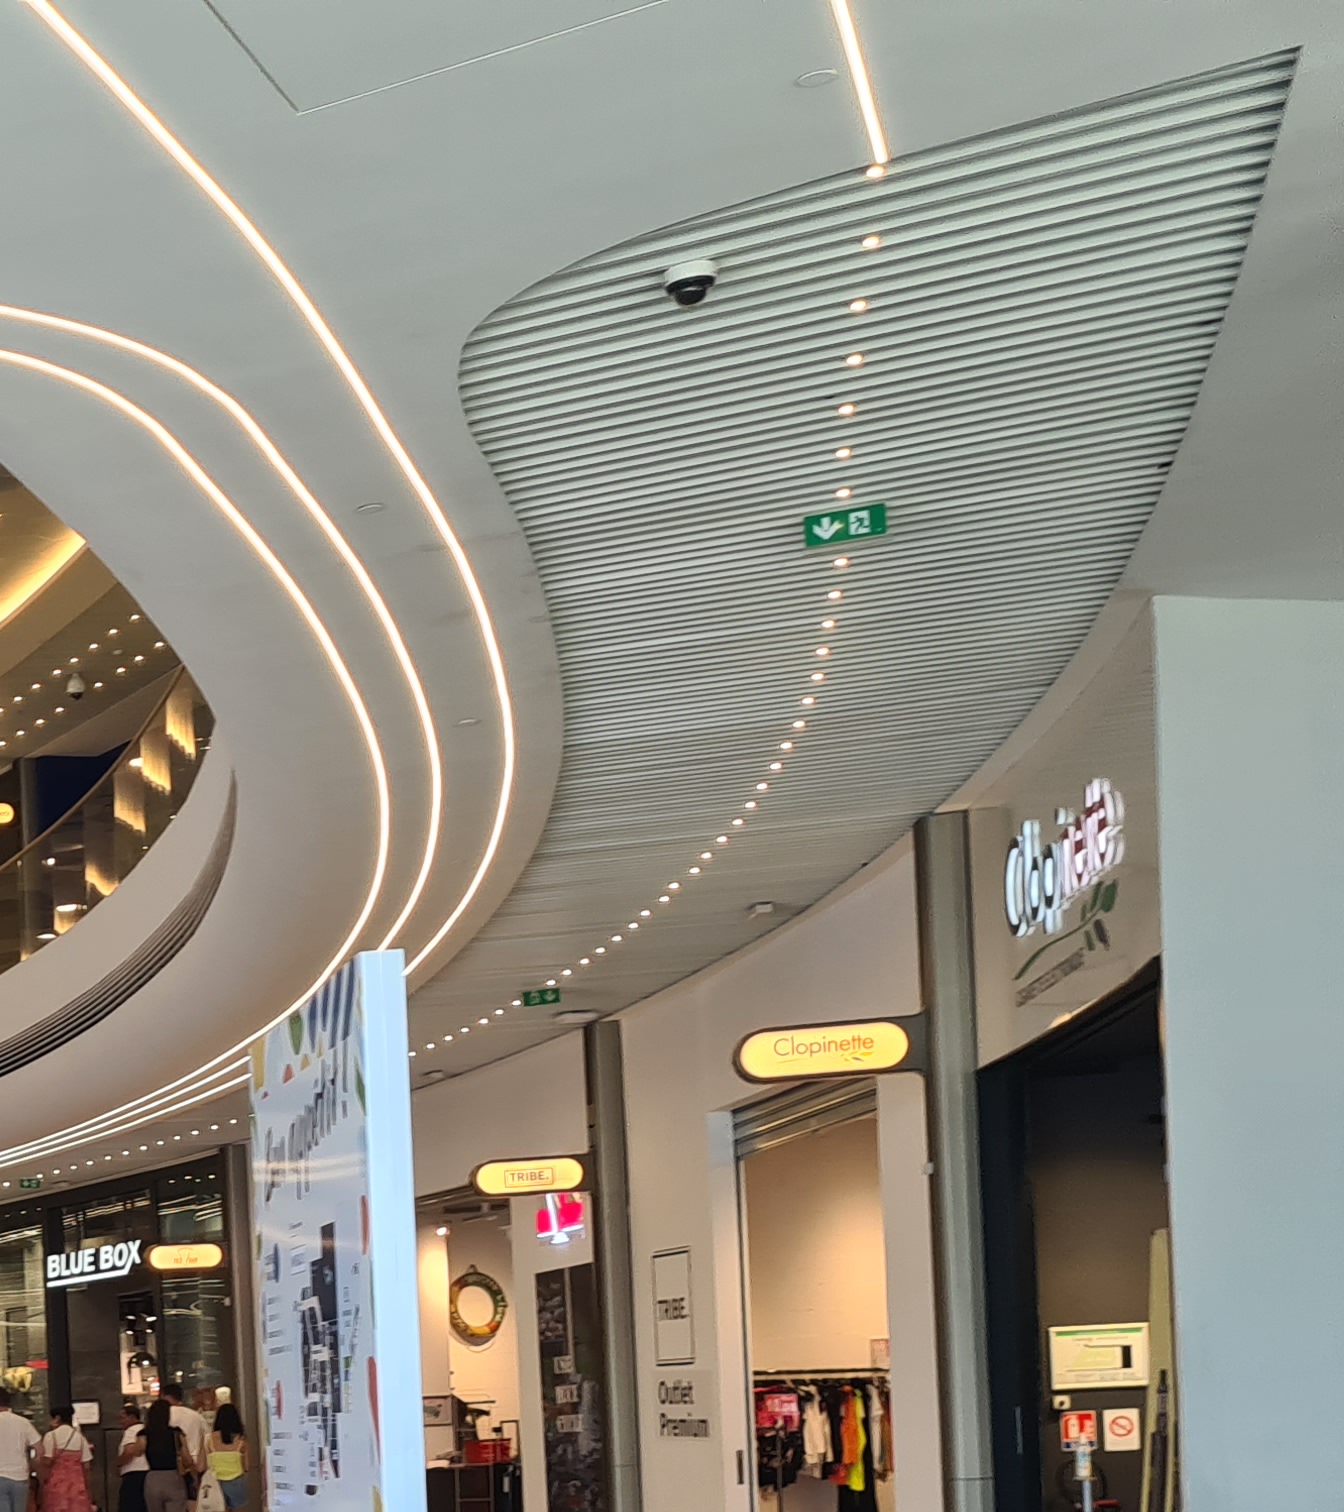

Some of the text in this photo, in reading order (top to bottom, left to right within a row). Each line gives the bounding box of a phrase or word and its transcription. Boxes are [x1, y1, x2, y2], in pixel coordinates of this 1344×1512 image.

[774, 1035, 874, 1057] Clopinette
[47, 1240, 142, 1278] BLUE BOX
